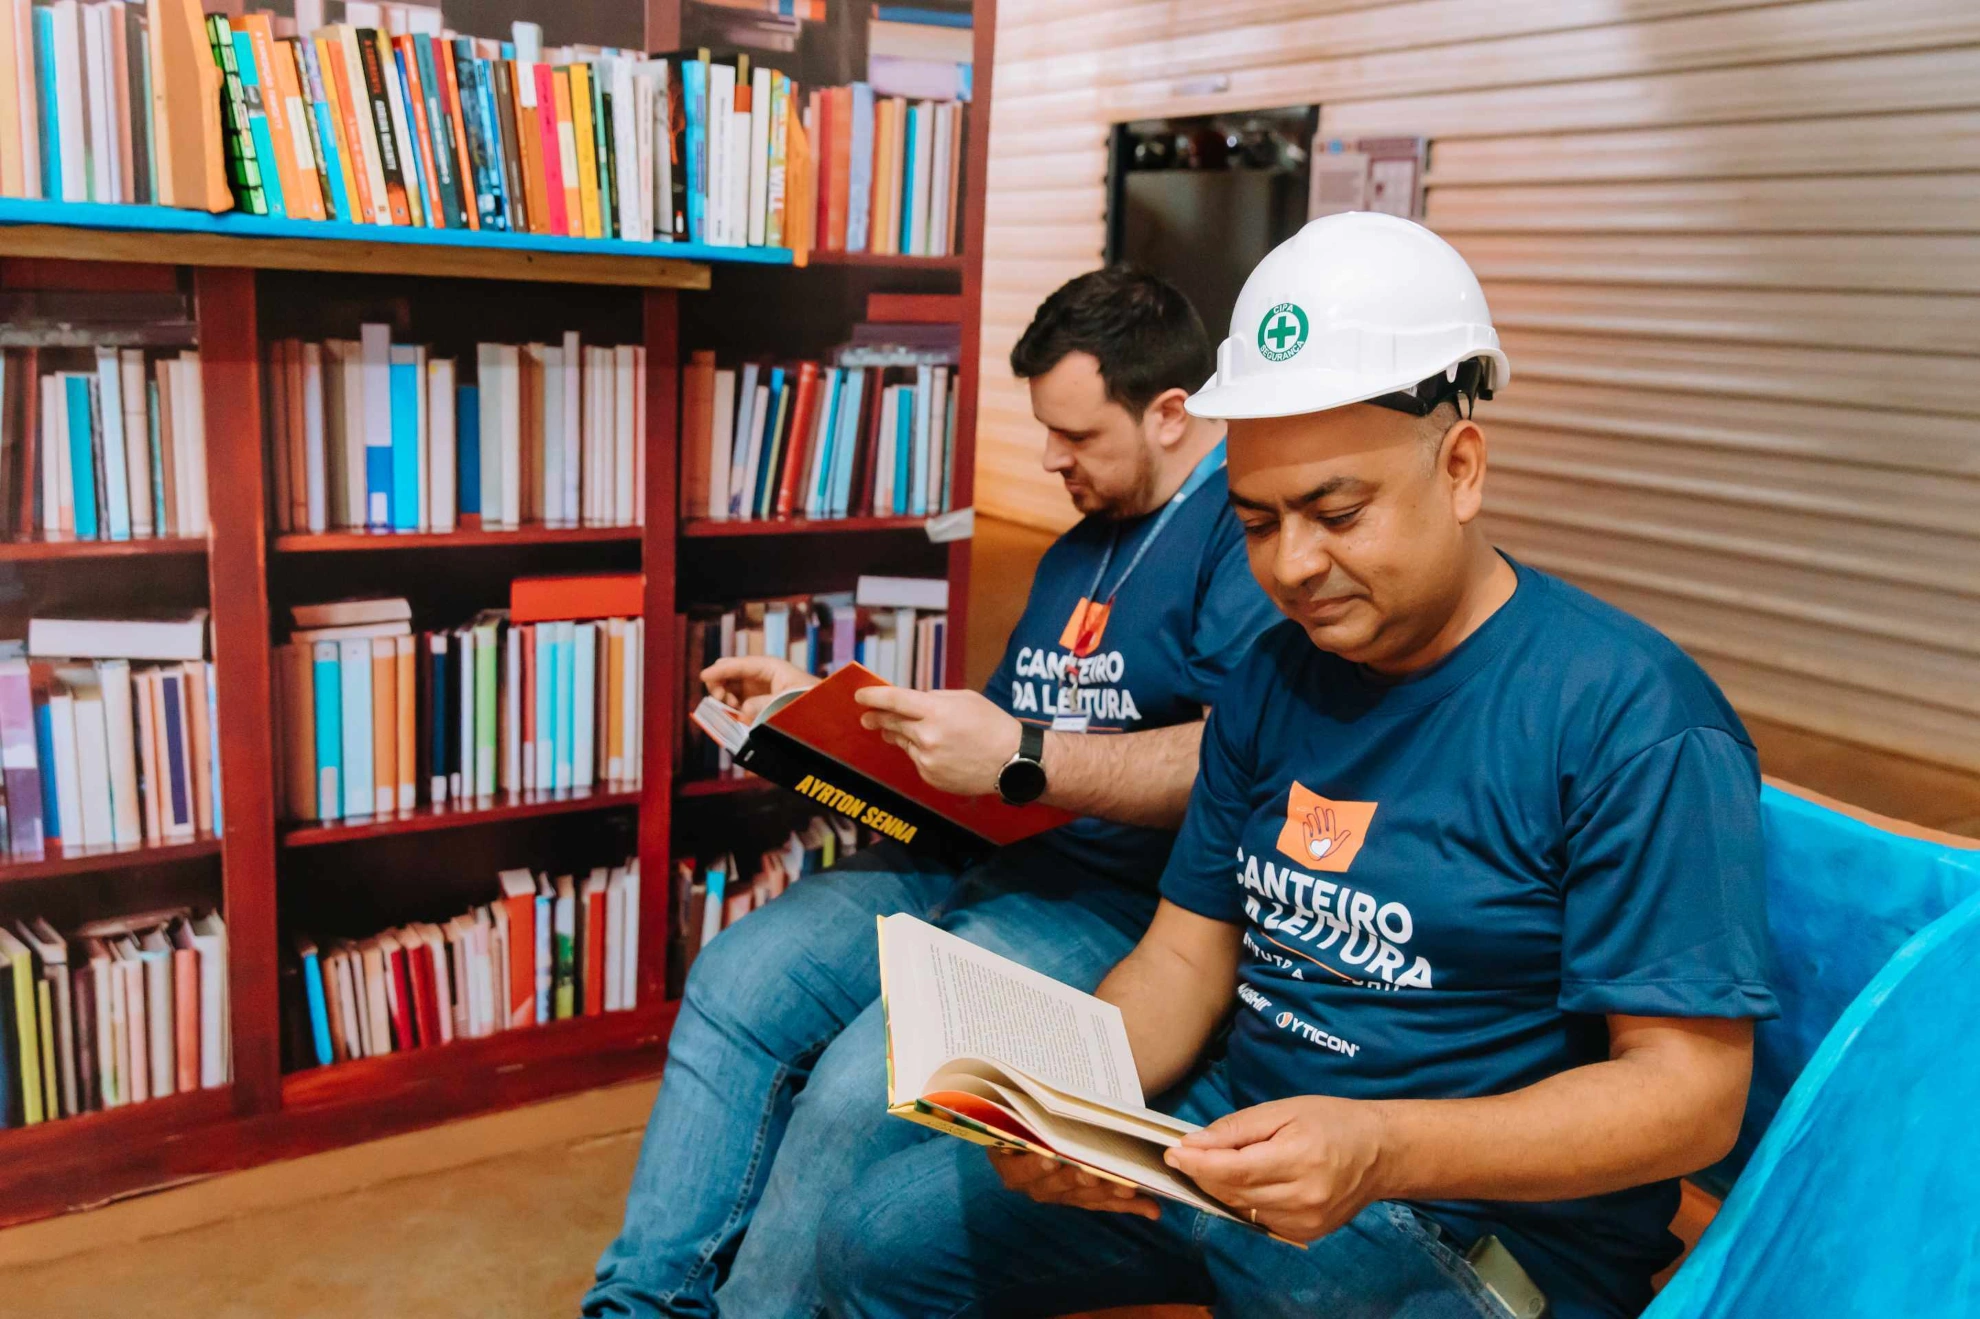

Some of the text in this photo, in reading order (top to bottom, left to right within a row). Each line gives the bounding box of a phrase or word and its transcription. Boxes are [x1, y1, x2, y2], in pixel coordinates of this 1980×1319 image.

[1273, 303, 1294, 314] CIPA
[1016, 647, 1124, 685] CANEIRO
[795, 774, 918, 844] AYRTON SENNA
